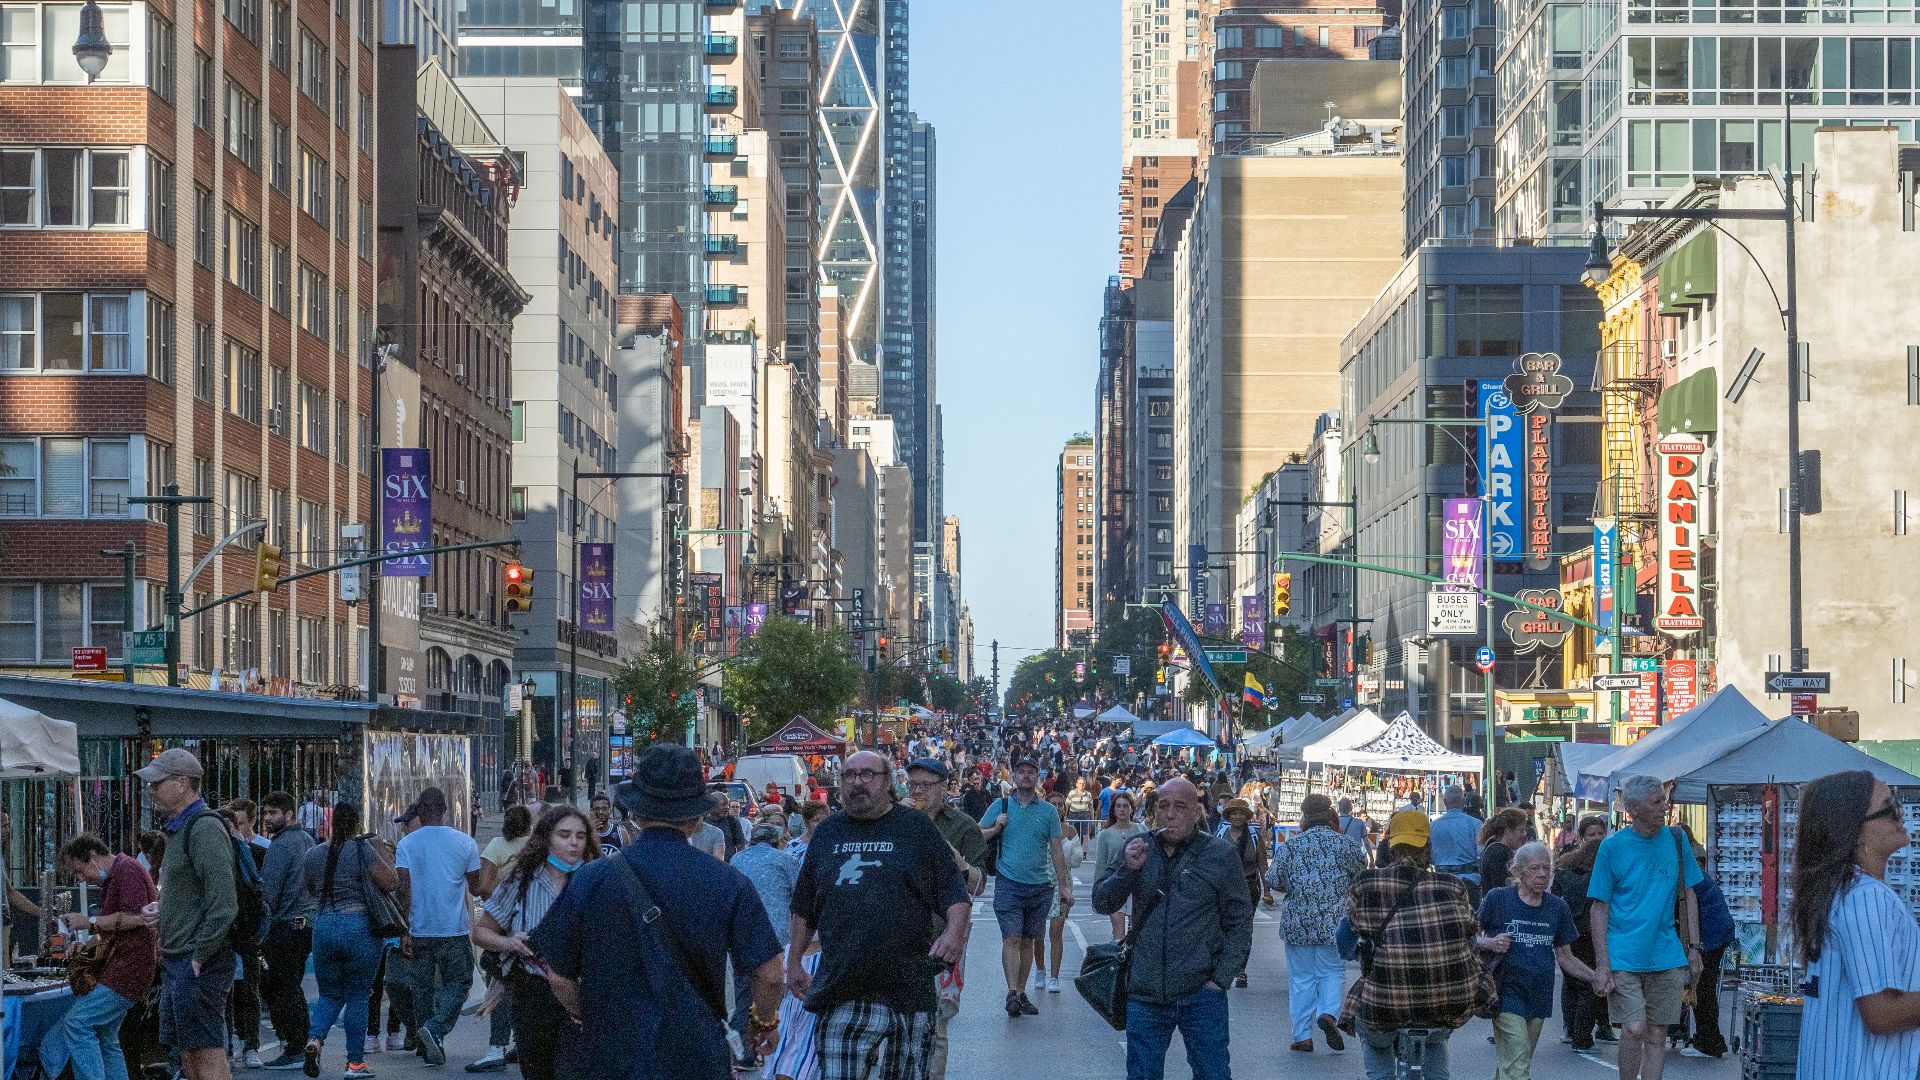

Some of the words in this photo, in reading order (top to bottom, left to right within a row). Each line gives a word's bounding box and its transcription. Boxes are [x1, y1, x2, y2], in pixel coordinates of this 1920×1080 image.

[1527, 360, 1555, 371] BAR
[1536, 373, 1545, 382] &
[1521, 384, 1562, 395] GRILL
[1660, 443, 1701, 452] TRATTORIA
[1490, 414, 1514, 526] PARK
[1530, 415, 1551, 560] PLAYWRIGHT
[1667, 455, 1697, 616] DANIELA
[1600, 536, 1611, 561] GIFT
[1195, 582, 1205, 622] Garden
[1437, 595, 1468, 604] BUSES
[1527, 596, 1556, 608] BAR
[708, 586, 721, 638] HOTEL
[1440, 609, 1464, 618] ONLY
[1538, 609, 1546, 620] &
[1521, 622, 1563, 634] GRILL
[1659, 618, 1701, 627] TRATTORIA
[133, 633, 142, 643] W
[144, 633, 156, 646] 45
[1639, 660, 1648, 670] 45
[1775, 678, 1794, 687] ONE
[1801, 678, 1822, 687] WAY
[1532, 709, 1560, 719] CELTIC
[1562, 708, 1578, 718] PUB
[833, 844, 840, 854] I
[841, 842, 894, 853] SURVIVED
